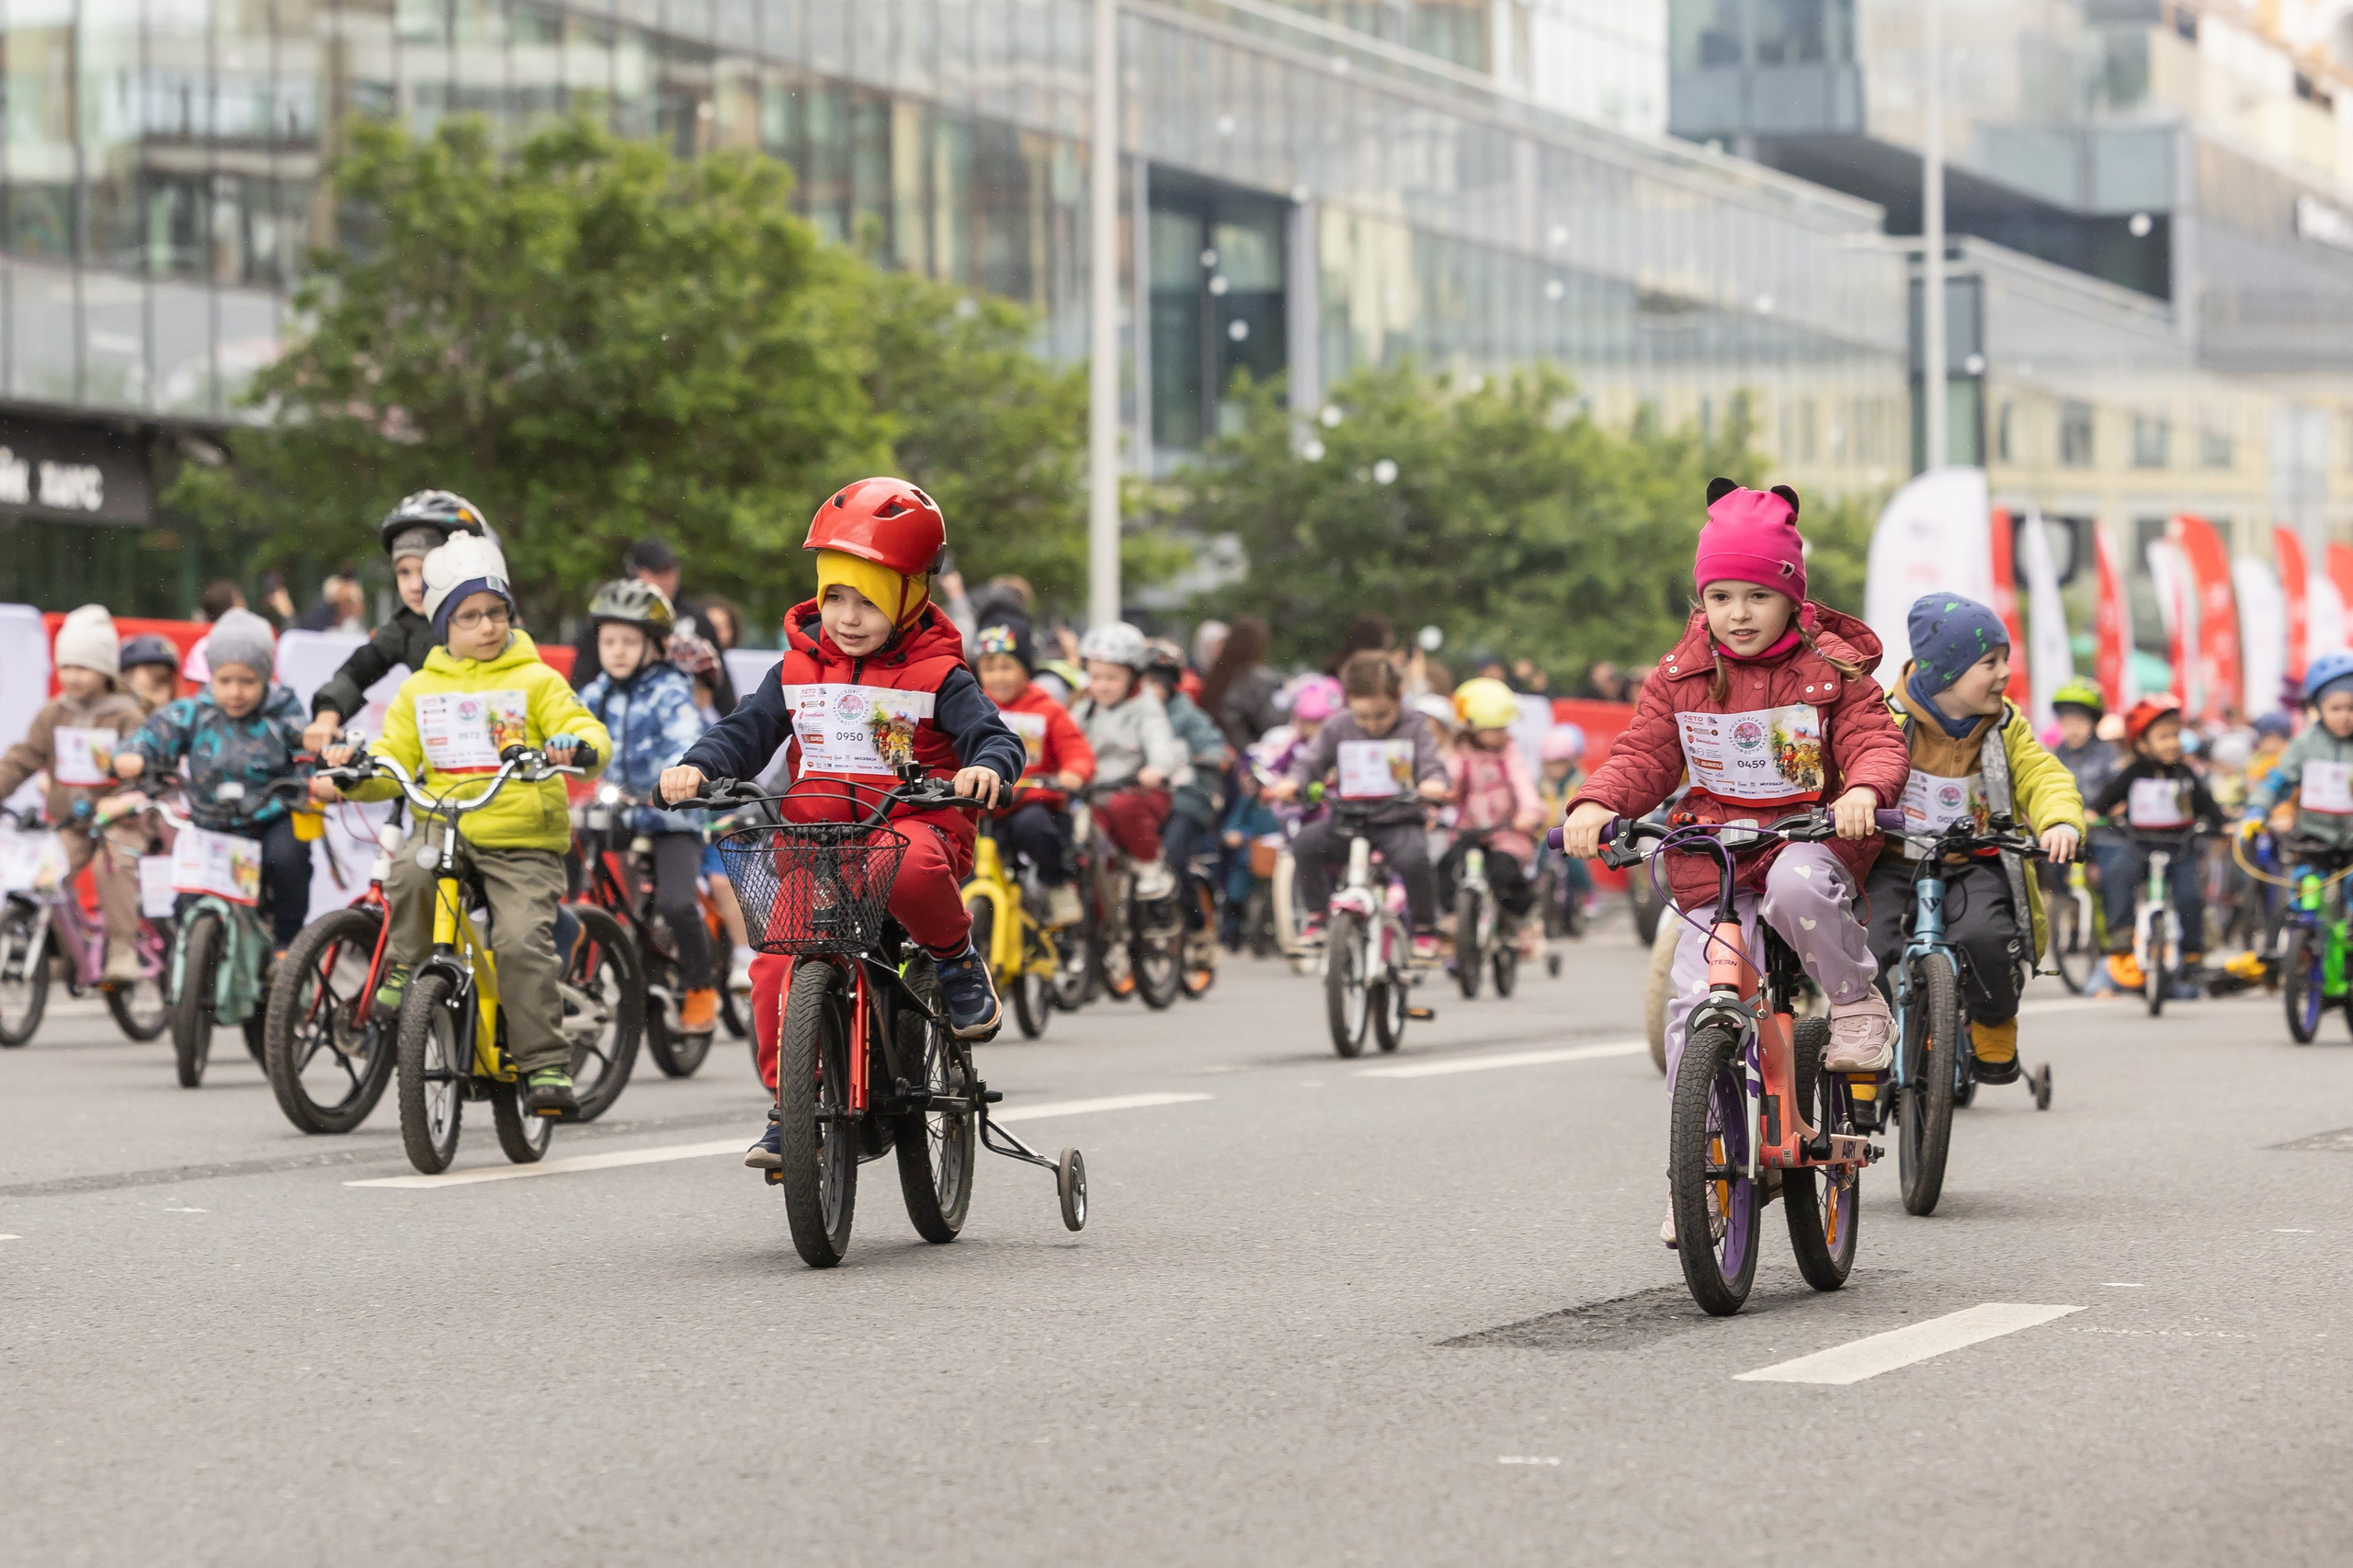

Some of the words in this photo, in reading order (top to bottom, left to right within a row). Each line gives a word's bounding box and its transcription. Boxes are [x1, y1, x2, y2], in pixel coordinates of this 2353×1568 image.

[1728, 717, 1766, 733] МОСКОВСКИЙ
[836, 732, 864, 742] 0950
[1737, 759, 1767, 769] 0459
[1710, 959, 1738, 967] STERN
[1842, 1141, 1857, 1159] AIRY
